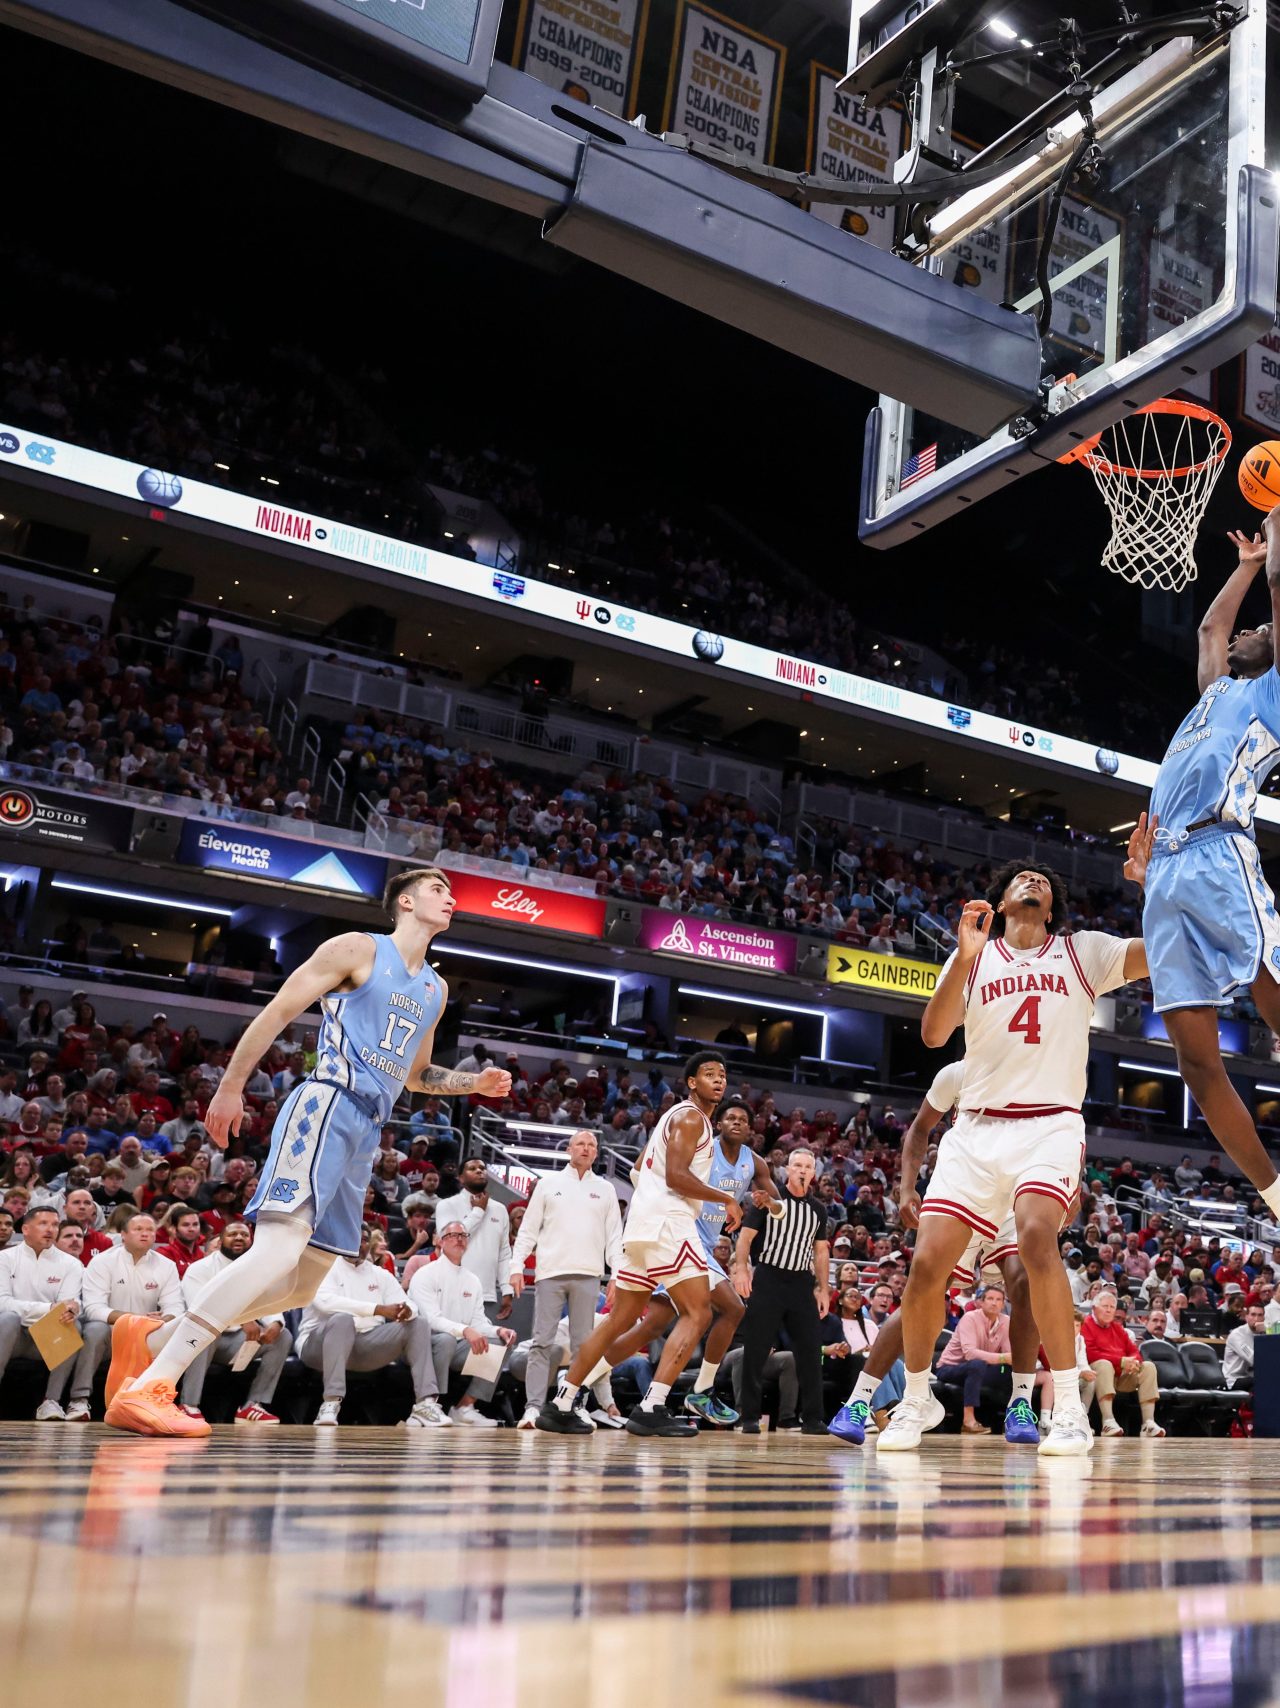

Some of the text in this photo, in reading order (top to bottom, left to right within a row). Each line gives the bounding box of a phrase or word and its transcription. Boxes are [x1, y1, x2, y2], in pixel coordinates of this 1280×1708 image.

[539, 16, 623, 74] CHAMPIONS
[700, 26, 758, 75] NBA
[690, 65, 761, 113] DIVISION
[692, 49, 763, 96] CENTRAL
[684, 109, 757, 156] 2003-04
[686, 85, 760, 137] CHAMPIONS
[832, 92, 886, 137] NBA
[827, 115, 890, 158] CENTRAL
[1060, 208, 1104, 243] NBA
[256, 505, 429, 575] INDIANA NORTH CAROLINA
[776, 657, 901, 709] INDIANA NORTH CAROLINA
[36, 808, 87, 825] MOTORS
[198, 833, 271, 859] Elevance
[231, 854, 269, 869] Health
[491, 888, 544, 922] Lilly
[697, 941, 776, 969] St. Vincent
[700, 923, 775, 950] Ascension
[857, 959, 937, 991] GAINBRID
[980, 973, 1070, 1006] INDIANA
[389, 992, 424, 1021] NORTH
[1008, 995, 1042, 1044] 4
[379, 1012, 417, 1058] 17
[719, 1179, 743, 1188] NORTH
